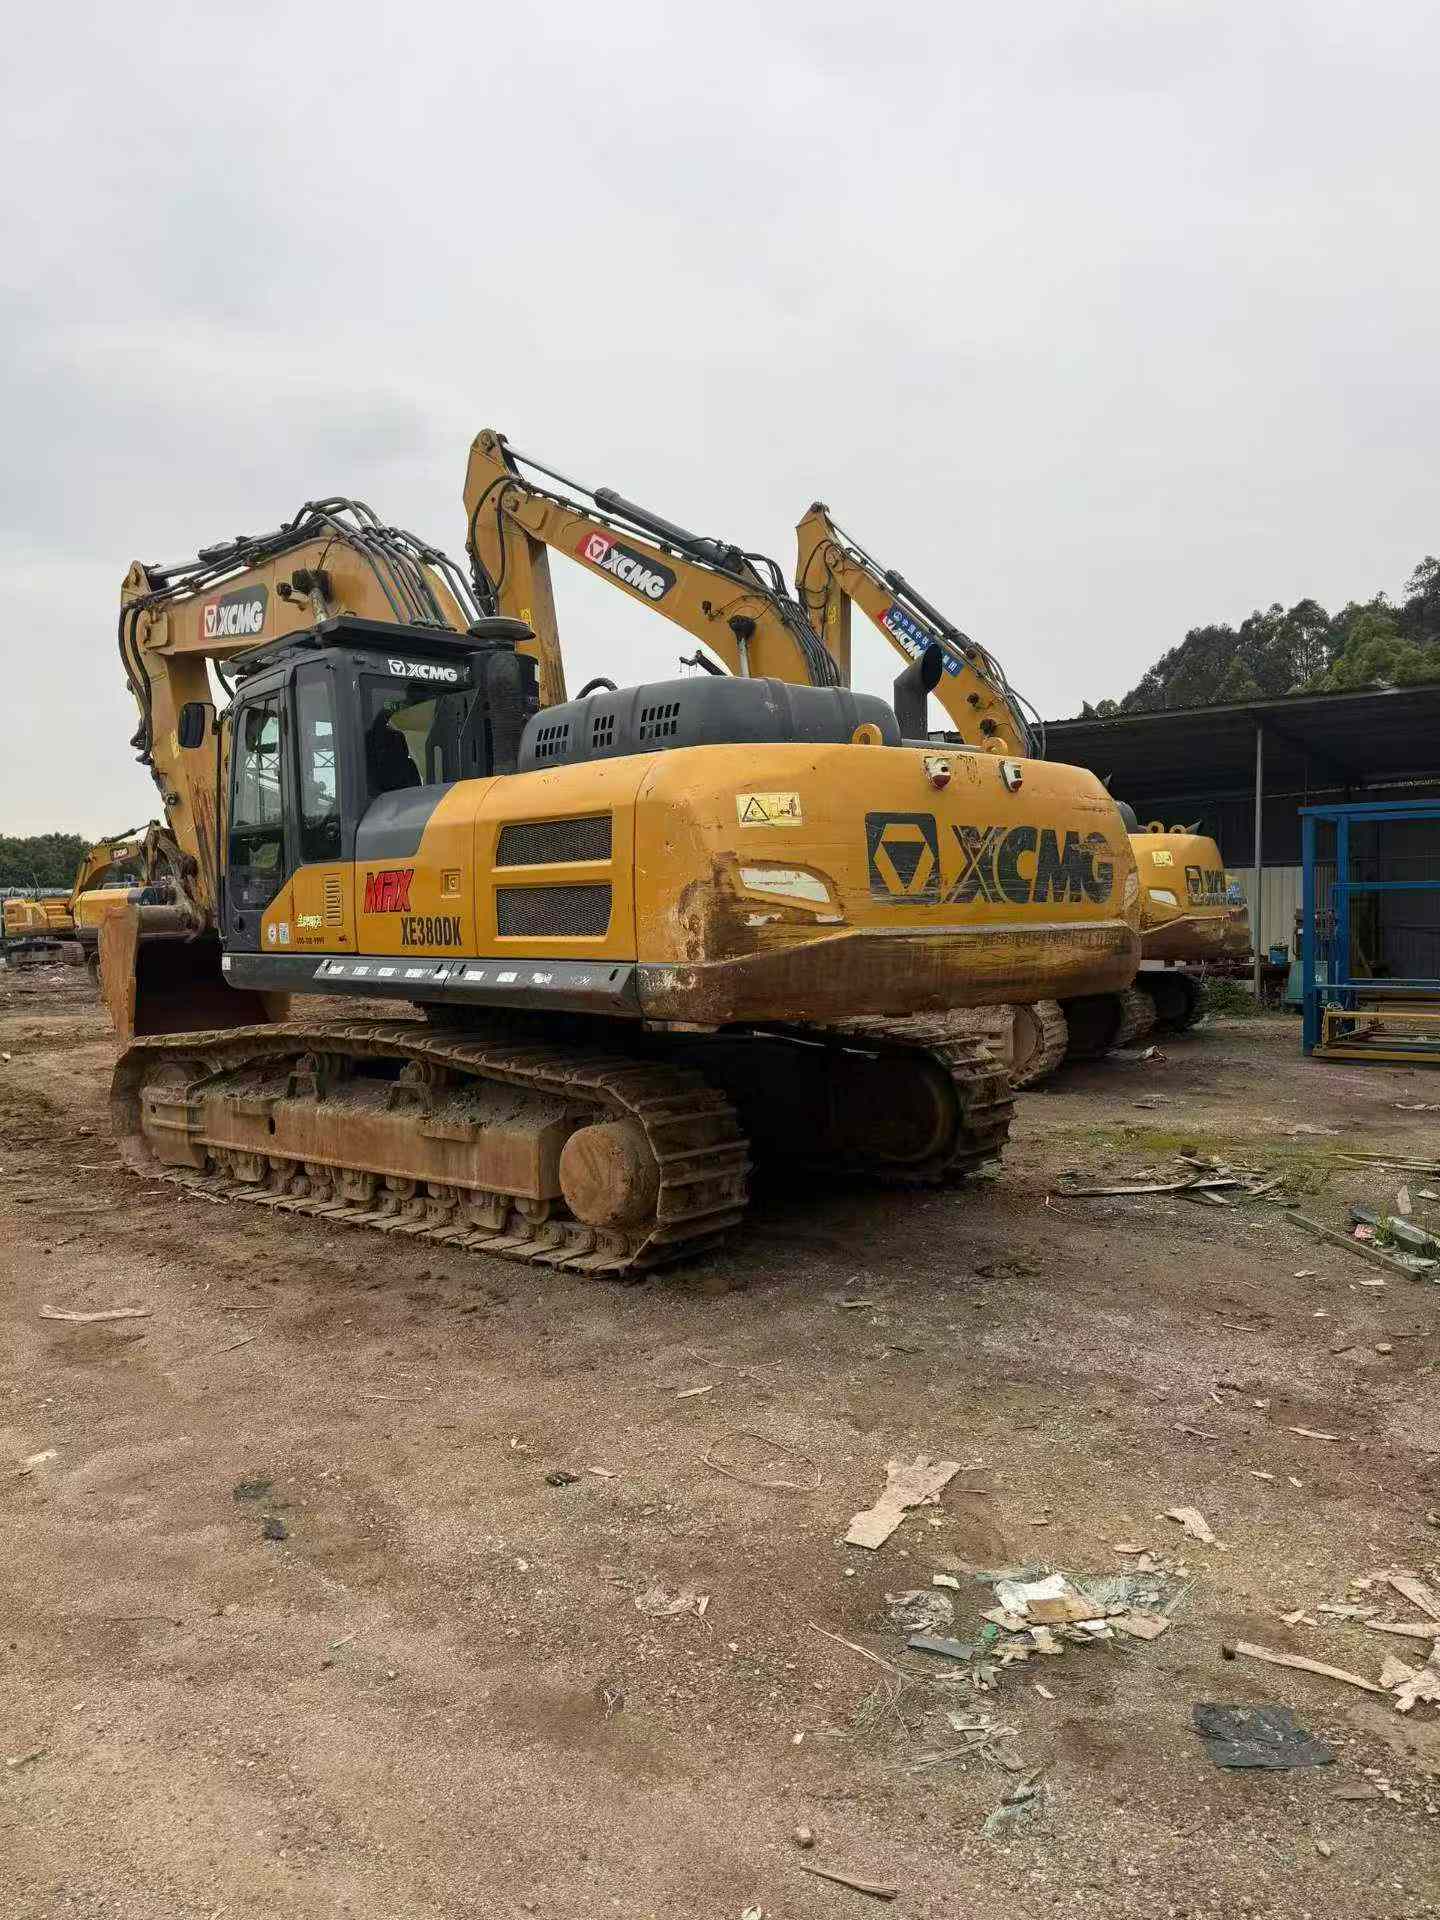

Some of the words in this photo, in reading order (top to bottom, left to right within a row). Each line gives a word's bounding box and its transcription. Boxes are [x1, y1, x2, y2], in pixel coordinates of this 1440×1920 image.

[600, 547, 665, 599] XCMG
[217, 601, 263, 636] XCMG
[406, 663, 458, 682] XCMG
[942, 824, 1114, 904] XCMG
[400, 916, 462, 946] XE380DK
